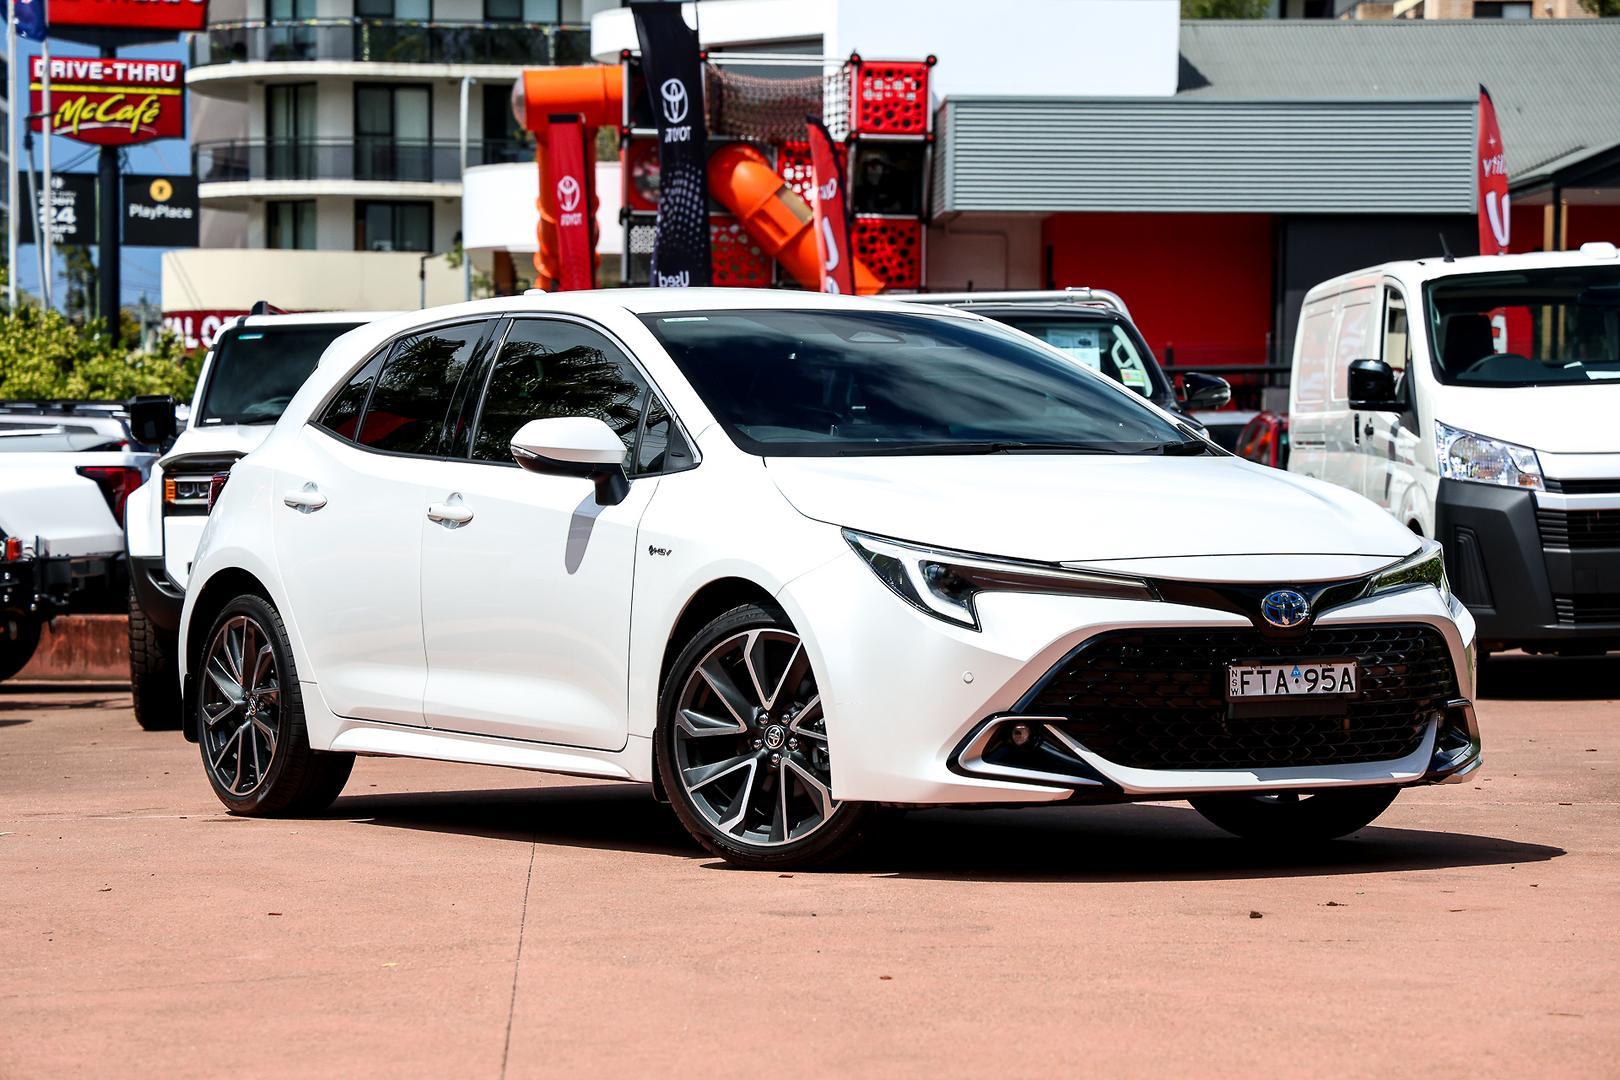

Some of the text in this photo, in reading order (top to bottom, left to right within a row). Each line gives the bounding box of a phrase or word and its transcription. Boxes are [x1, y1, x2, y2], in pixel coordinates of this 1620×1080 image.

[34, 60, 176, 82] DRIVE-THRU
[54, 94, 160, 135] McCafé
[129, 203, 193, 220] PlayPlace
[1231, 669, 1239, 695] NSW
